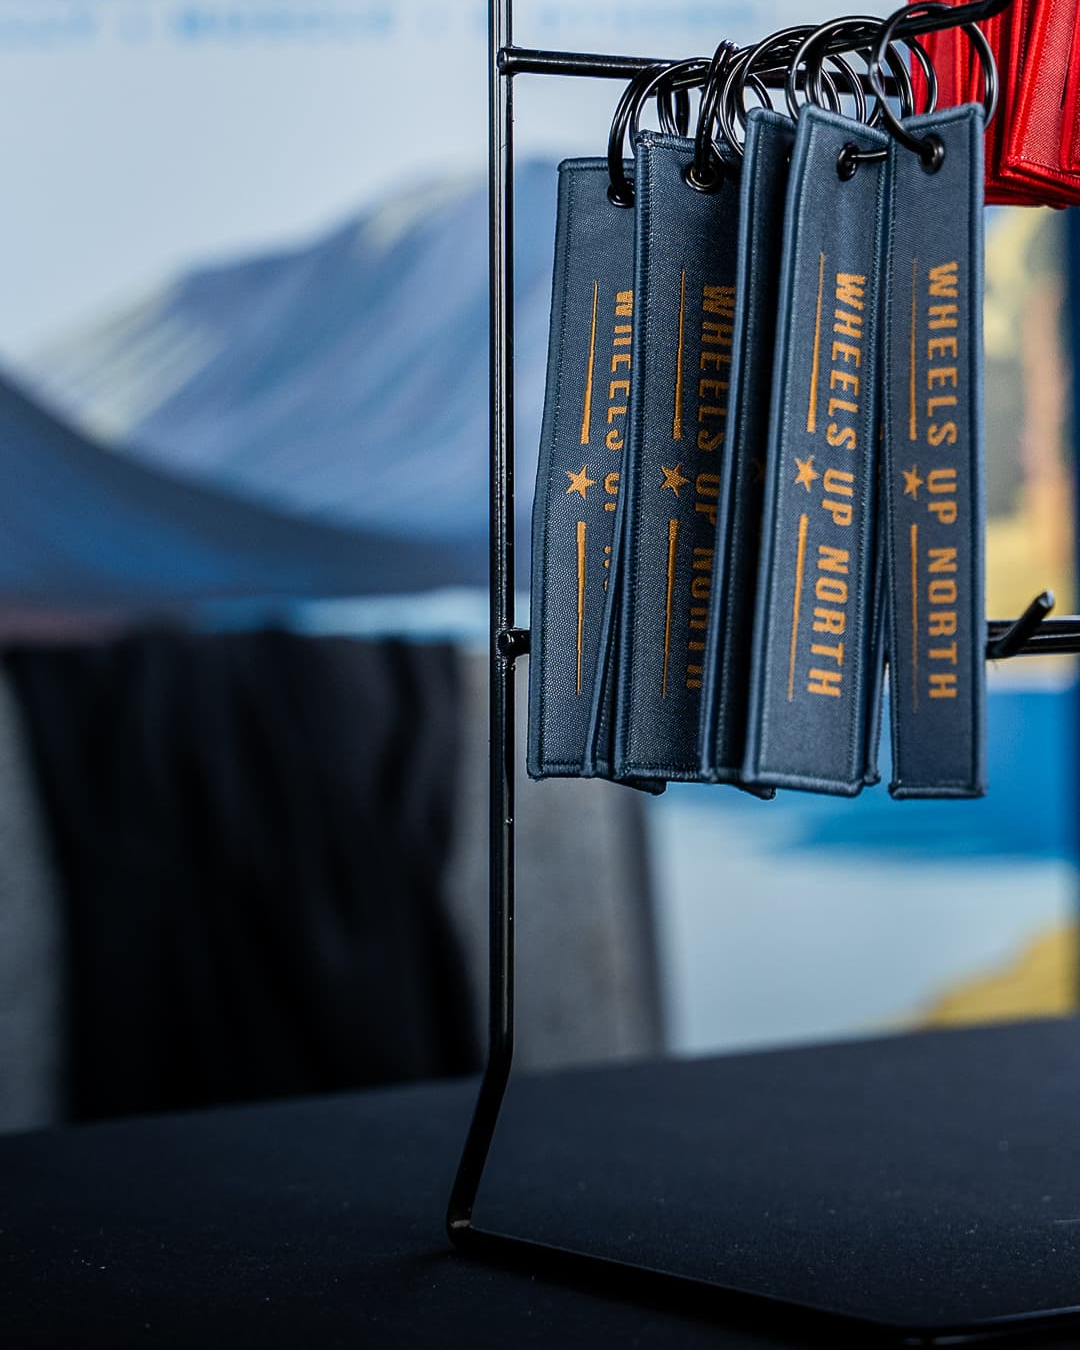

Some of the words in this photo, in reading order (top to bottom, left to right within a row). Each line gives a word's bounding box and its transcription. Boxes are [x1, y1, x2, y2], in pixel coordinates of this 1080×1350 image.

[697, 286, 735, 450] WHEELS
[826, 273, 865, 449] WHEELS
[927, 262, 958, 446] WHEELS
[822, 469, 854, 526] UP
[927, 468, 957, 523] UP
[808, 546, 849, 696] NORTH
[928, 548, 957, 698] NORTH
